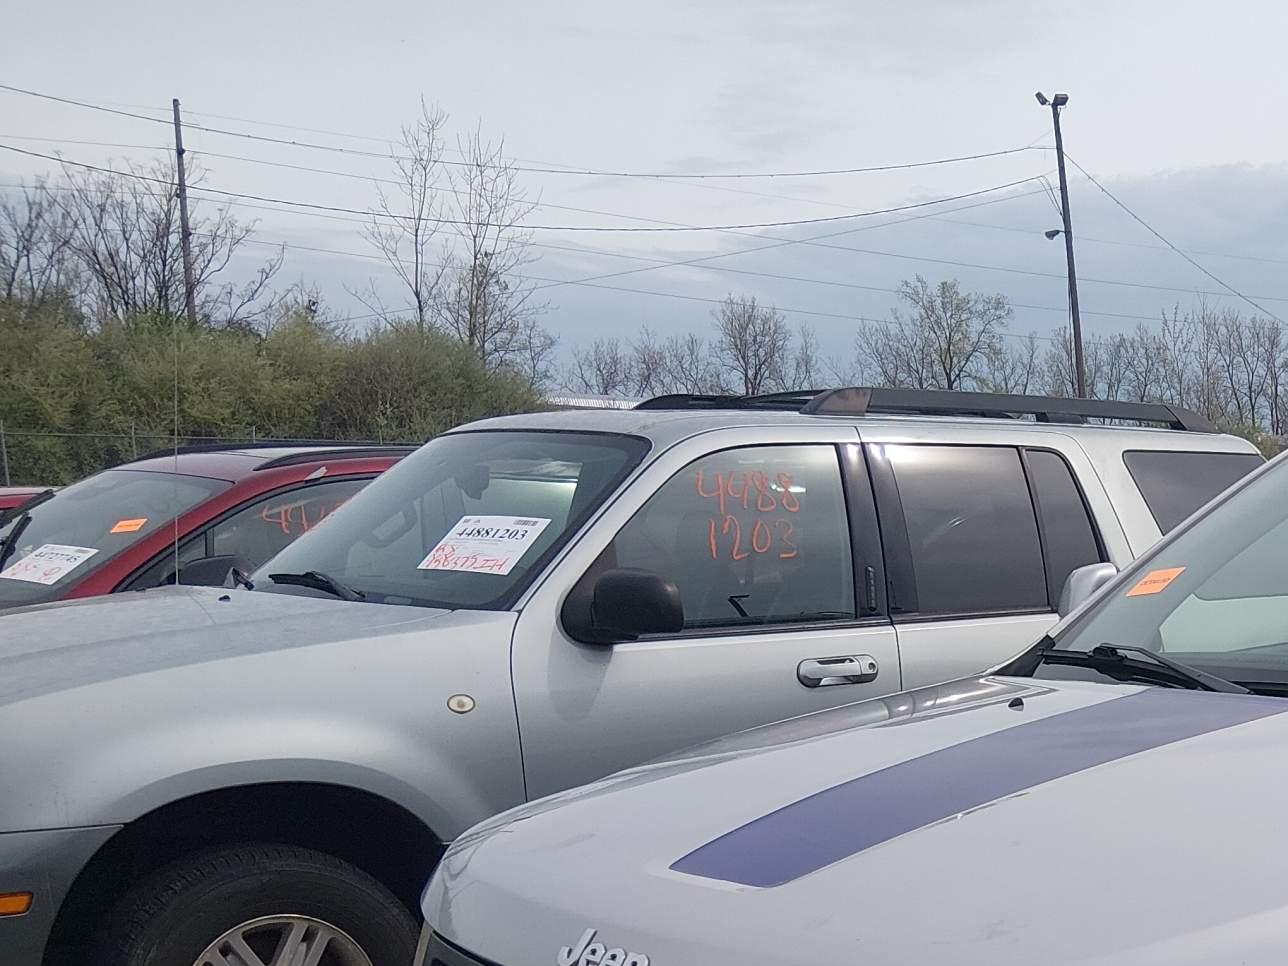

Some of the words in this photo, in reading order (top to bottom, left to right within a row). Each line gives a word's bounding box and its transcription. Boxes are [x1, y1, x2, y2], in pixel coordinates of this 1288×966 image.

[695, 470, 800, 514] 4488
[456, 527, 529, 541] 44881203
[709, 515, 799, 560] 1203
